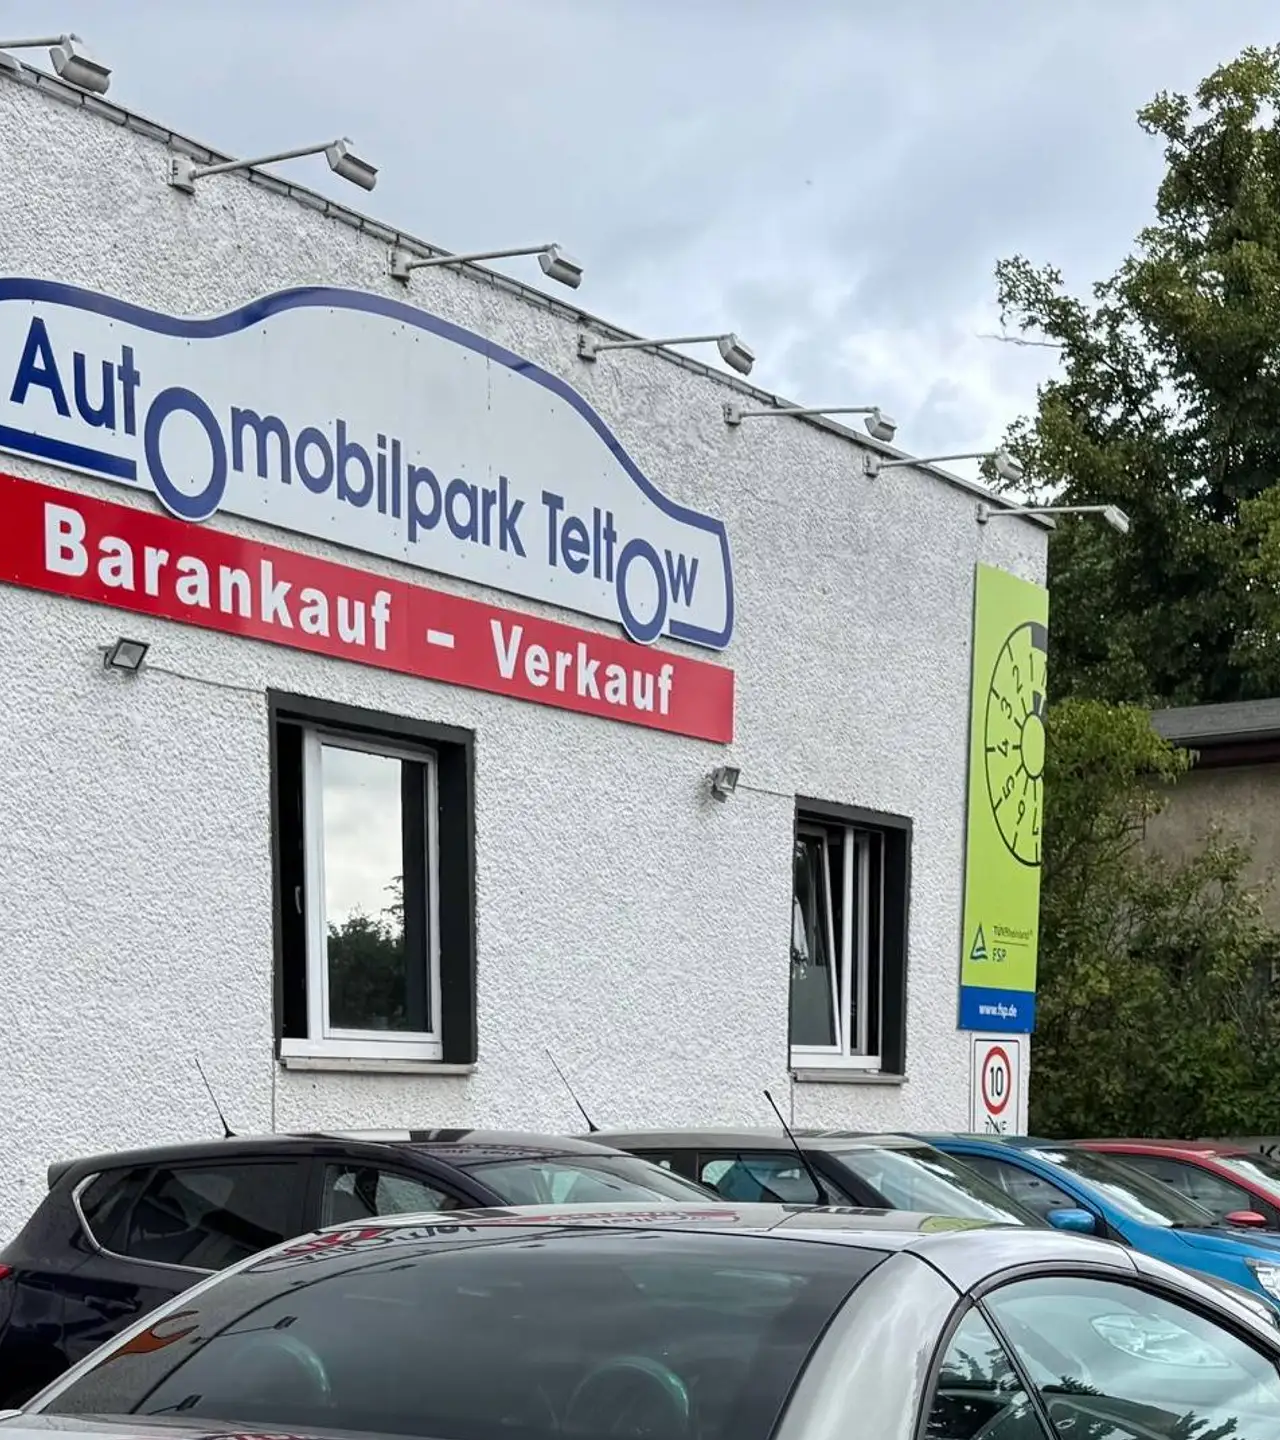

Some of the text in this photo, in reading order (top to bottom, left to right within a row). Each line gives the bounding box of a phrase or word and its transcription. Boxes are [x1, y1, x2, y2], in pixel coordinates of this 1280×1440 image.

[10, 316, 699, 646] Automobilpark Teltow
[43, 501, 394, 652] Barankauf
[490, 619, 677, 717] Verkauf
[989, 1066, 1004, 1097] 10
